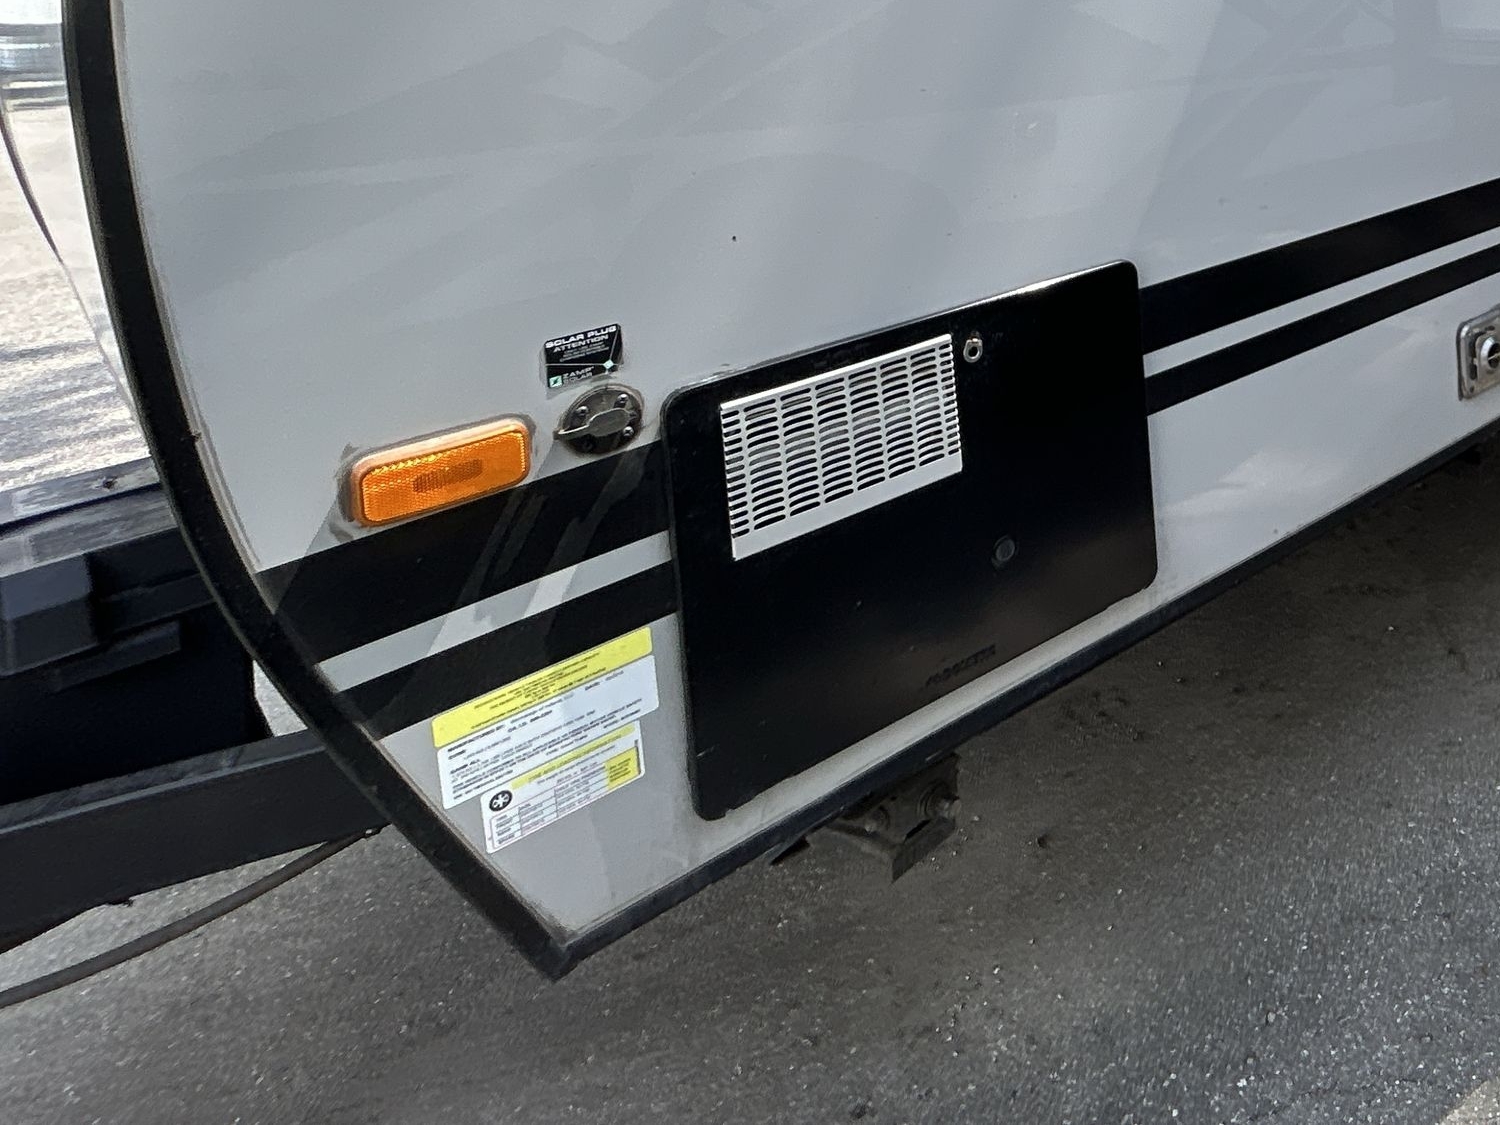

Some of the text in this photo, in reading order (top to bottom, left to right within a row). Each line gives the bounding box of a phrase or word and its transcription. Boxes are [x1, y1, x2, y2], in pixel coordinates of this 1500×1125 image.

[545, 325, 617, 349] SOLAR PLUG
[553, 334, 609, 352] ATTENTION
